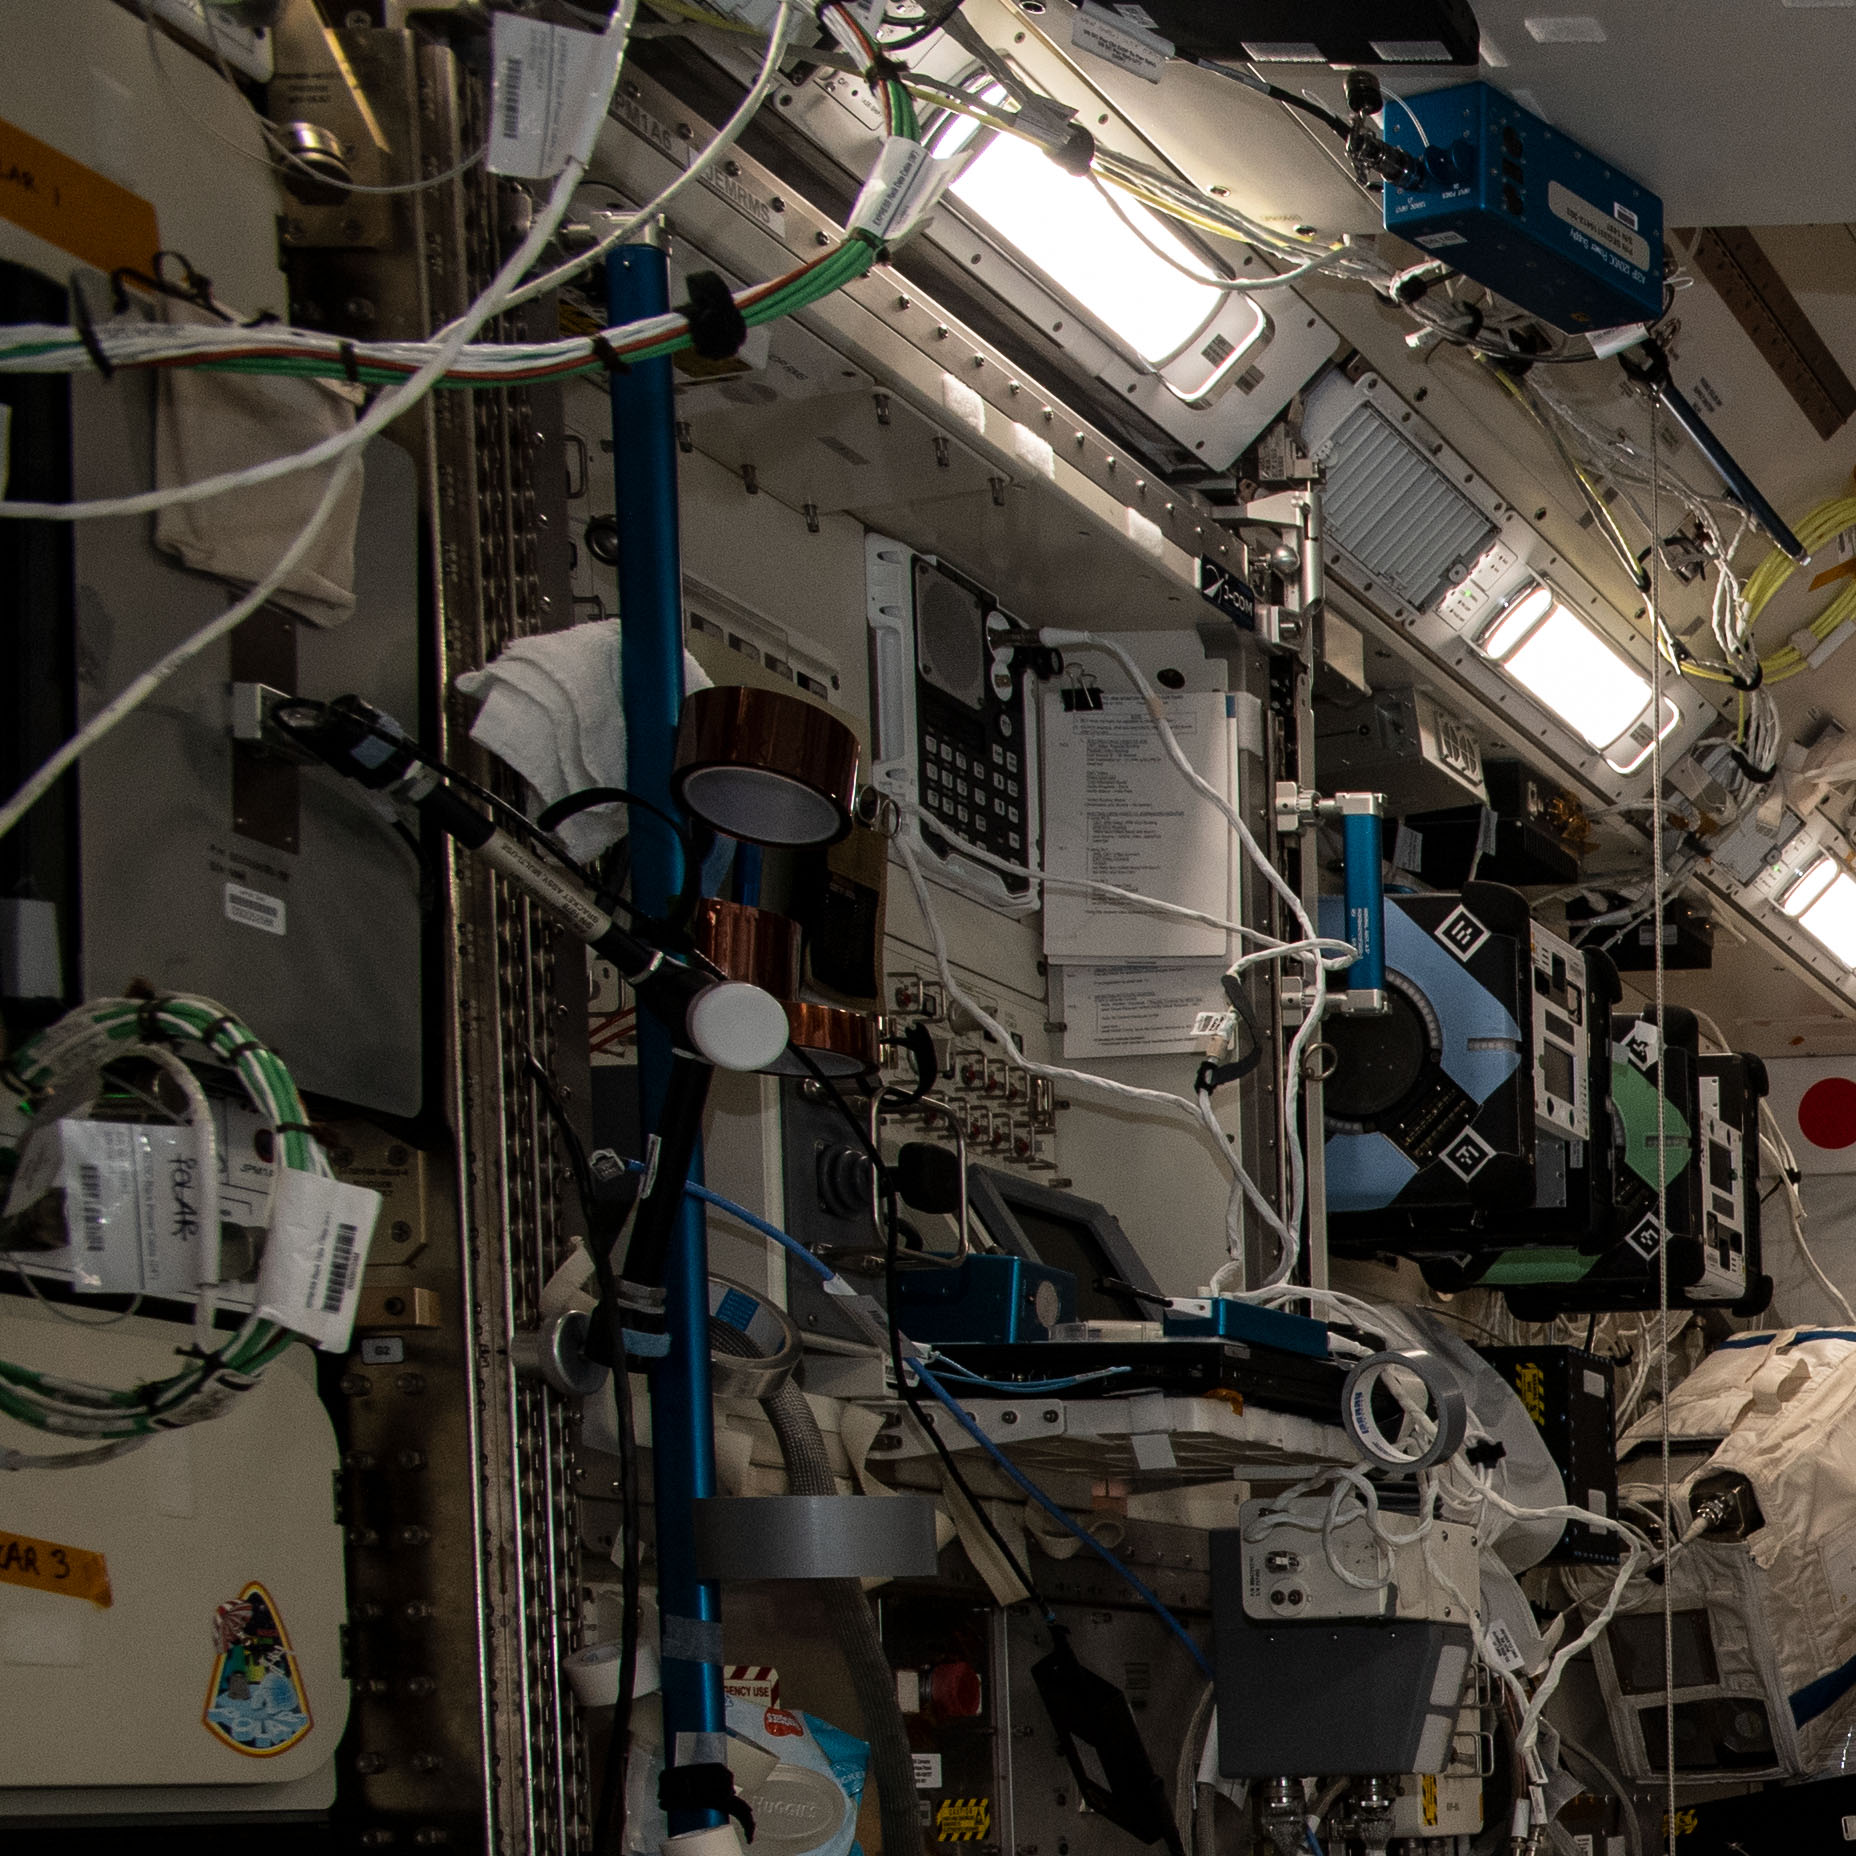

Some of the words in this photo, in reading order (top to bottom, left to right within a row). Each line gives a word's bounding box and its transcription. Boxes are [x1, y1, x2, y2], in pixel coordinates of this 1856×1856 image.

[171, 1158, 197, 1236] POLAR
[51, 1549, 71, 1578] 3
[749, 1685, 770, 1698] USE
